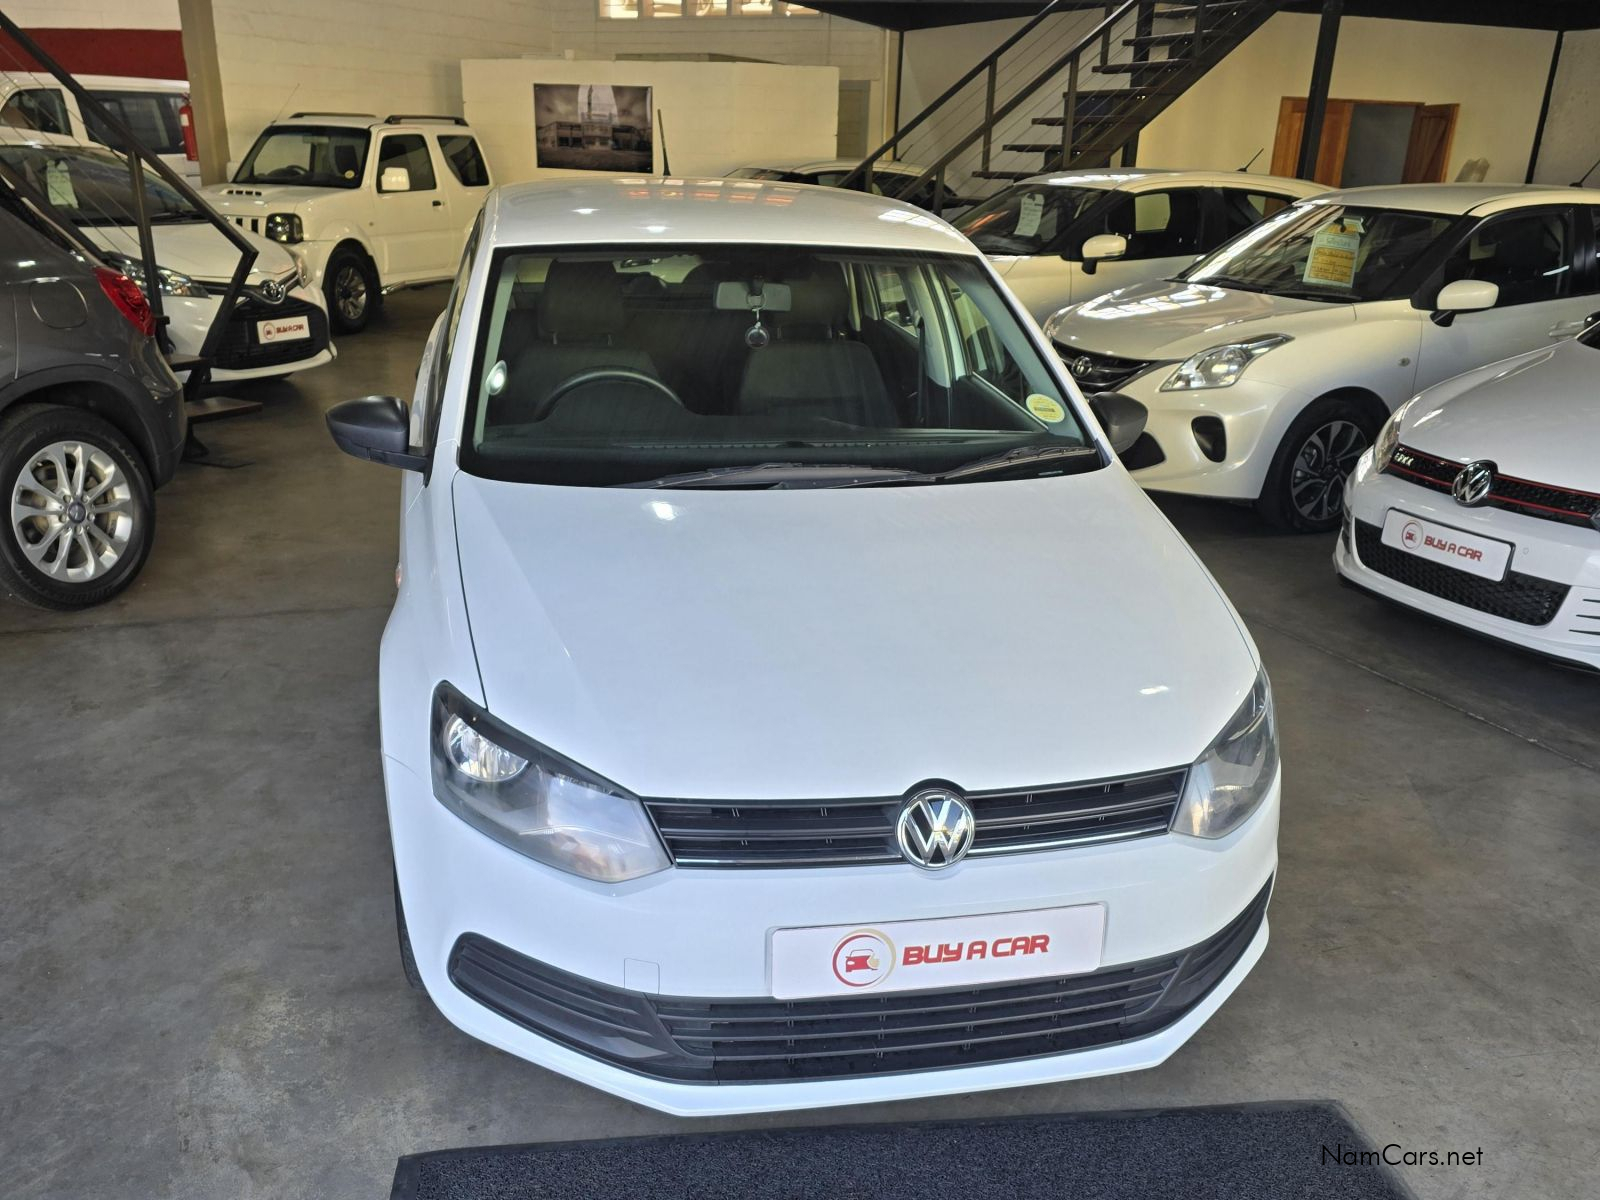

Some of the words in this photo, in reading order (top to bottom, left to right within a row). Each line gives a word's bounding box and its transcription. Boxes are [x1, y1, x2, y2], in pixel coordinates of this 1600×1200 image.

[1424, 535, 1448, 551] BUY
[1447, 543, 1457, 554] A
[1457, 545, 1483, 561] CAR
[902, 942, 964, 966] BUY
[966, 940, 988, 960] A
[991, 934, 1050, 958] CAR
